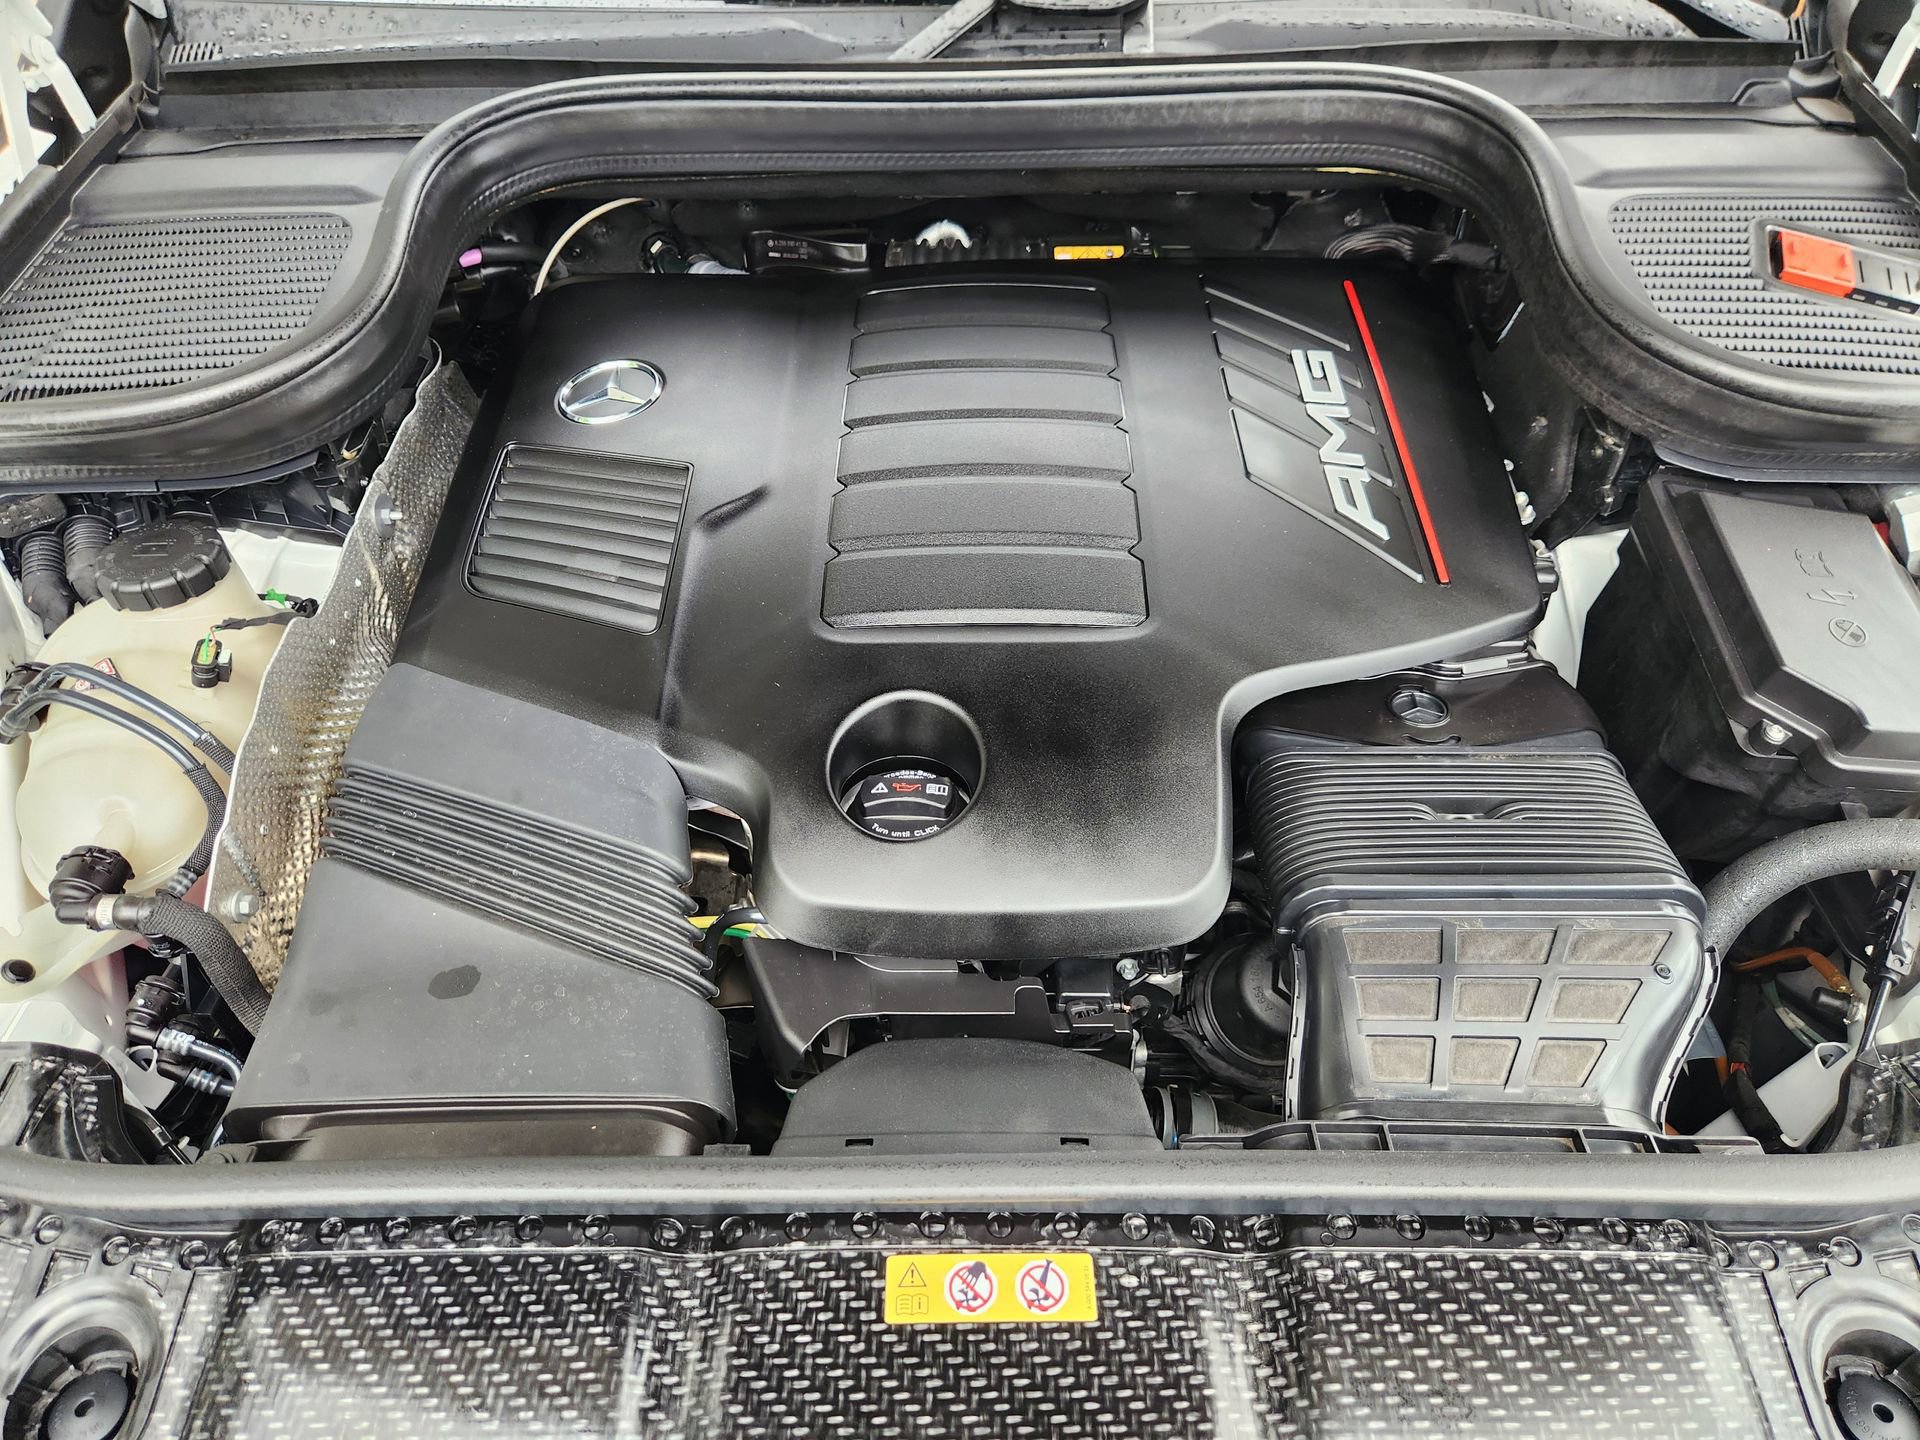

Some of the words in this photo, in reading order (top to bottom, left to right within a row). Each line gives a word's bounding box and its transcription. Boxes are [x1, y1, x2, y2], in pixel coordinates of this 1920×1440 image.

[1291, 349, 1391, 541] AMG
[871, 822, 889, 835] Turn
[891, 830, 911, 838] until
[913, 824, 941, 837] CLICK
